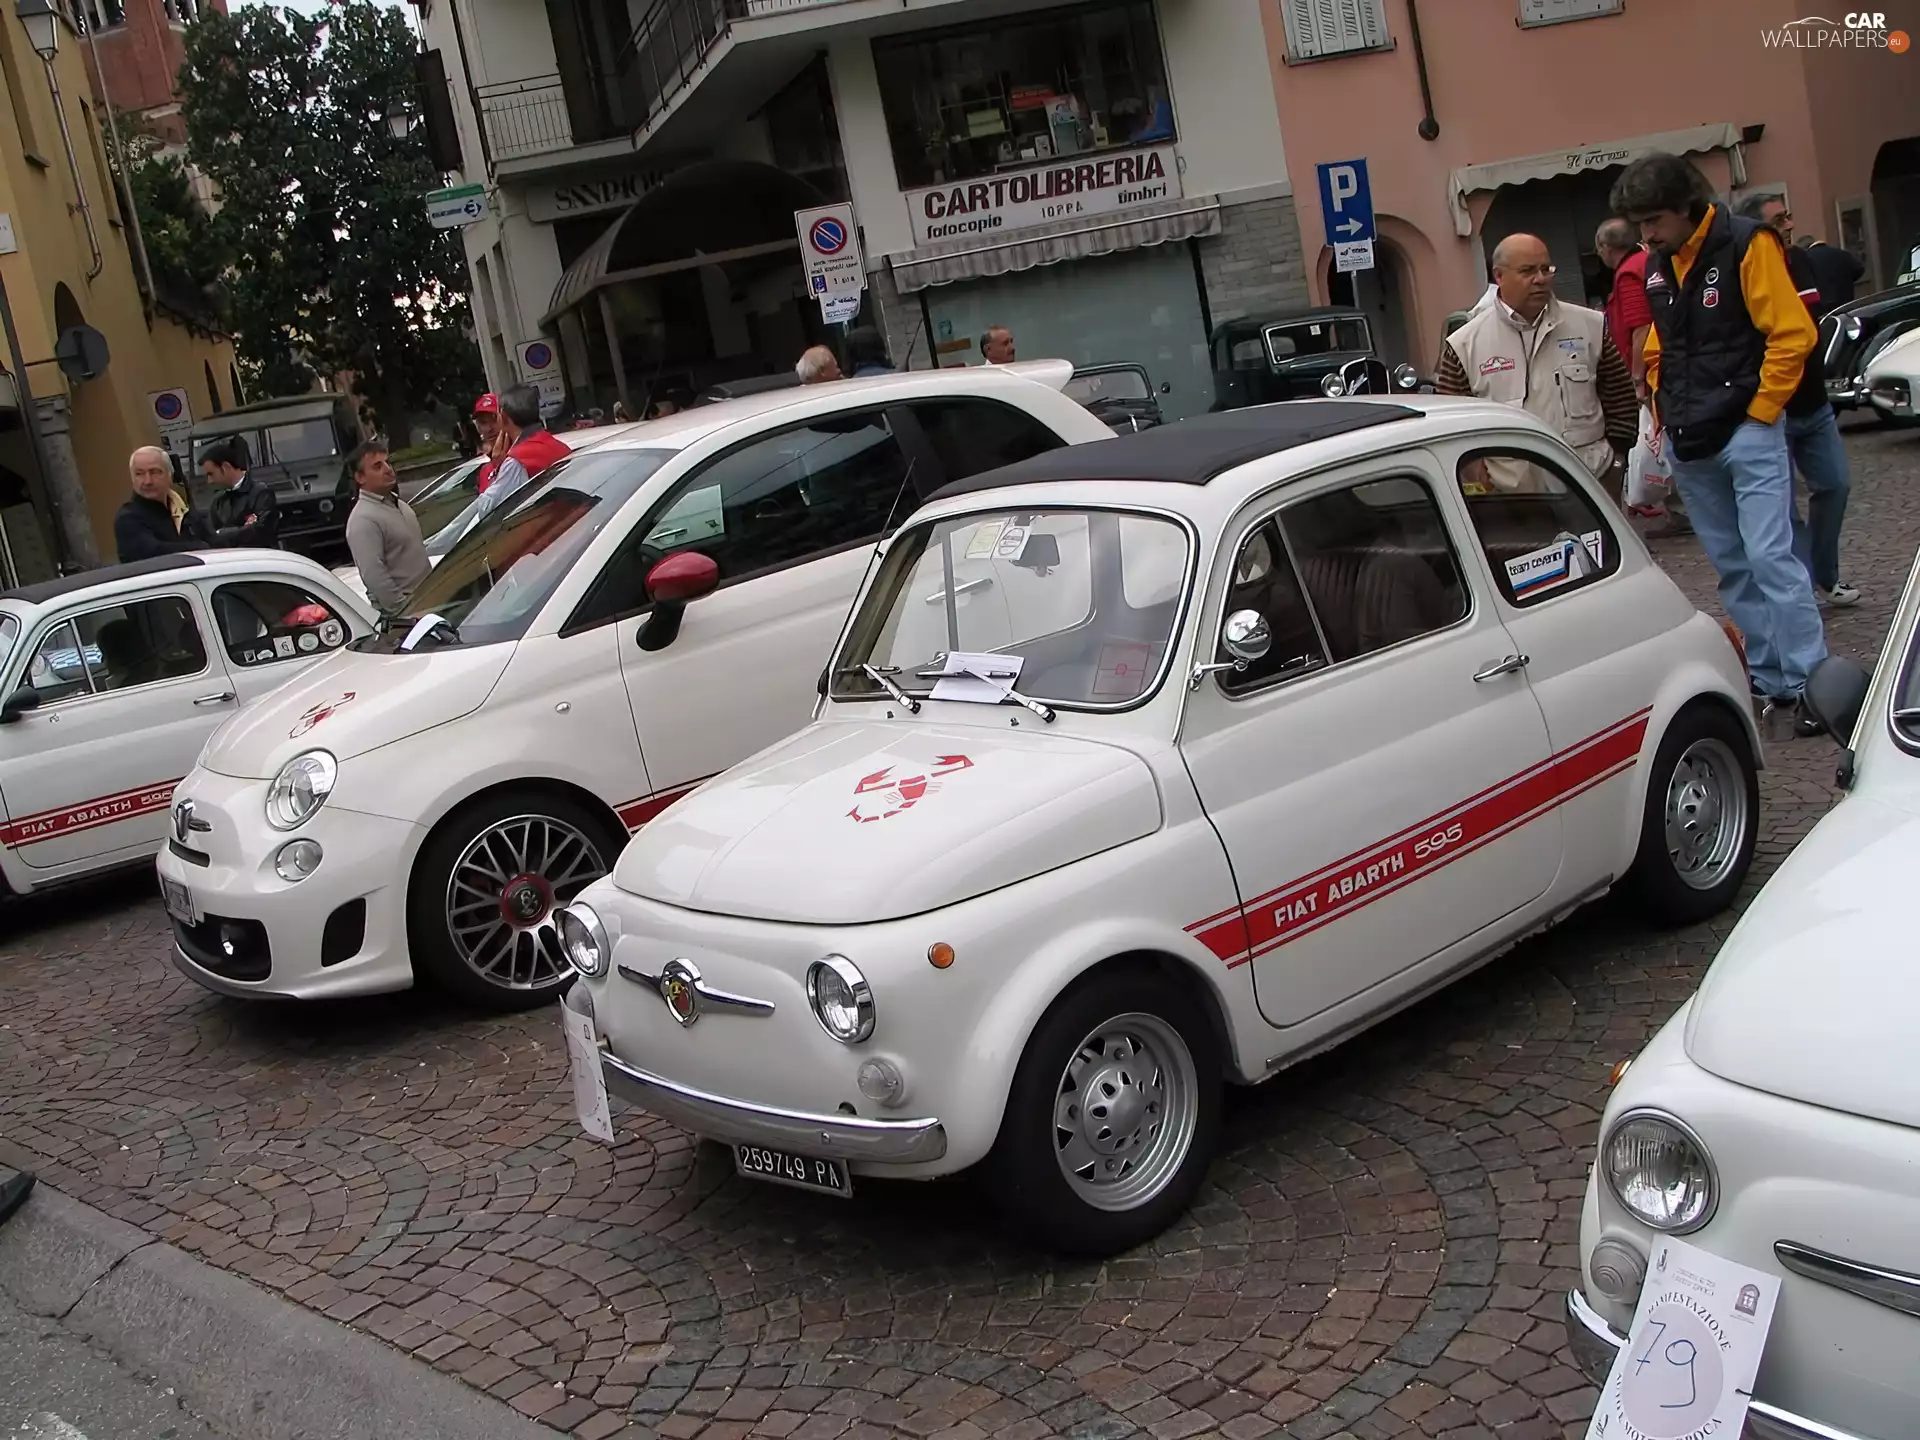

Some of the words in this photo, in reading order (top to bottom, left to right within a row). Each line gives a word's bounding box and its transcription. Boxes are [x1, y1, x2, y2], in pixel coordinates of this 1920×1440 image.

[924, 152, 1166, 219] CARTOLIBRERIA
[1117, 182, 1167, 204] timbri
[1328, 165, 1358, 212] P
[926, 214, 1002, 239] fotocopie
[21, 819, 55, 836] FIAT
[67, 800, 132, 825] ABARTH
[1273, 892, 1319, 928] FIAT
[1328, 851, 1405, 904] ABARTH
[1414, 822, 1464, 860] 595
[740, 1145, 806, 1180] 259749
[815, 1160, 840, 1188] PA
[1635, 1319, 1697, 1408] 79
